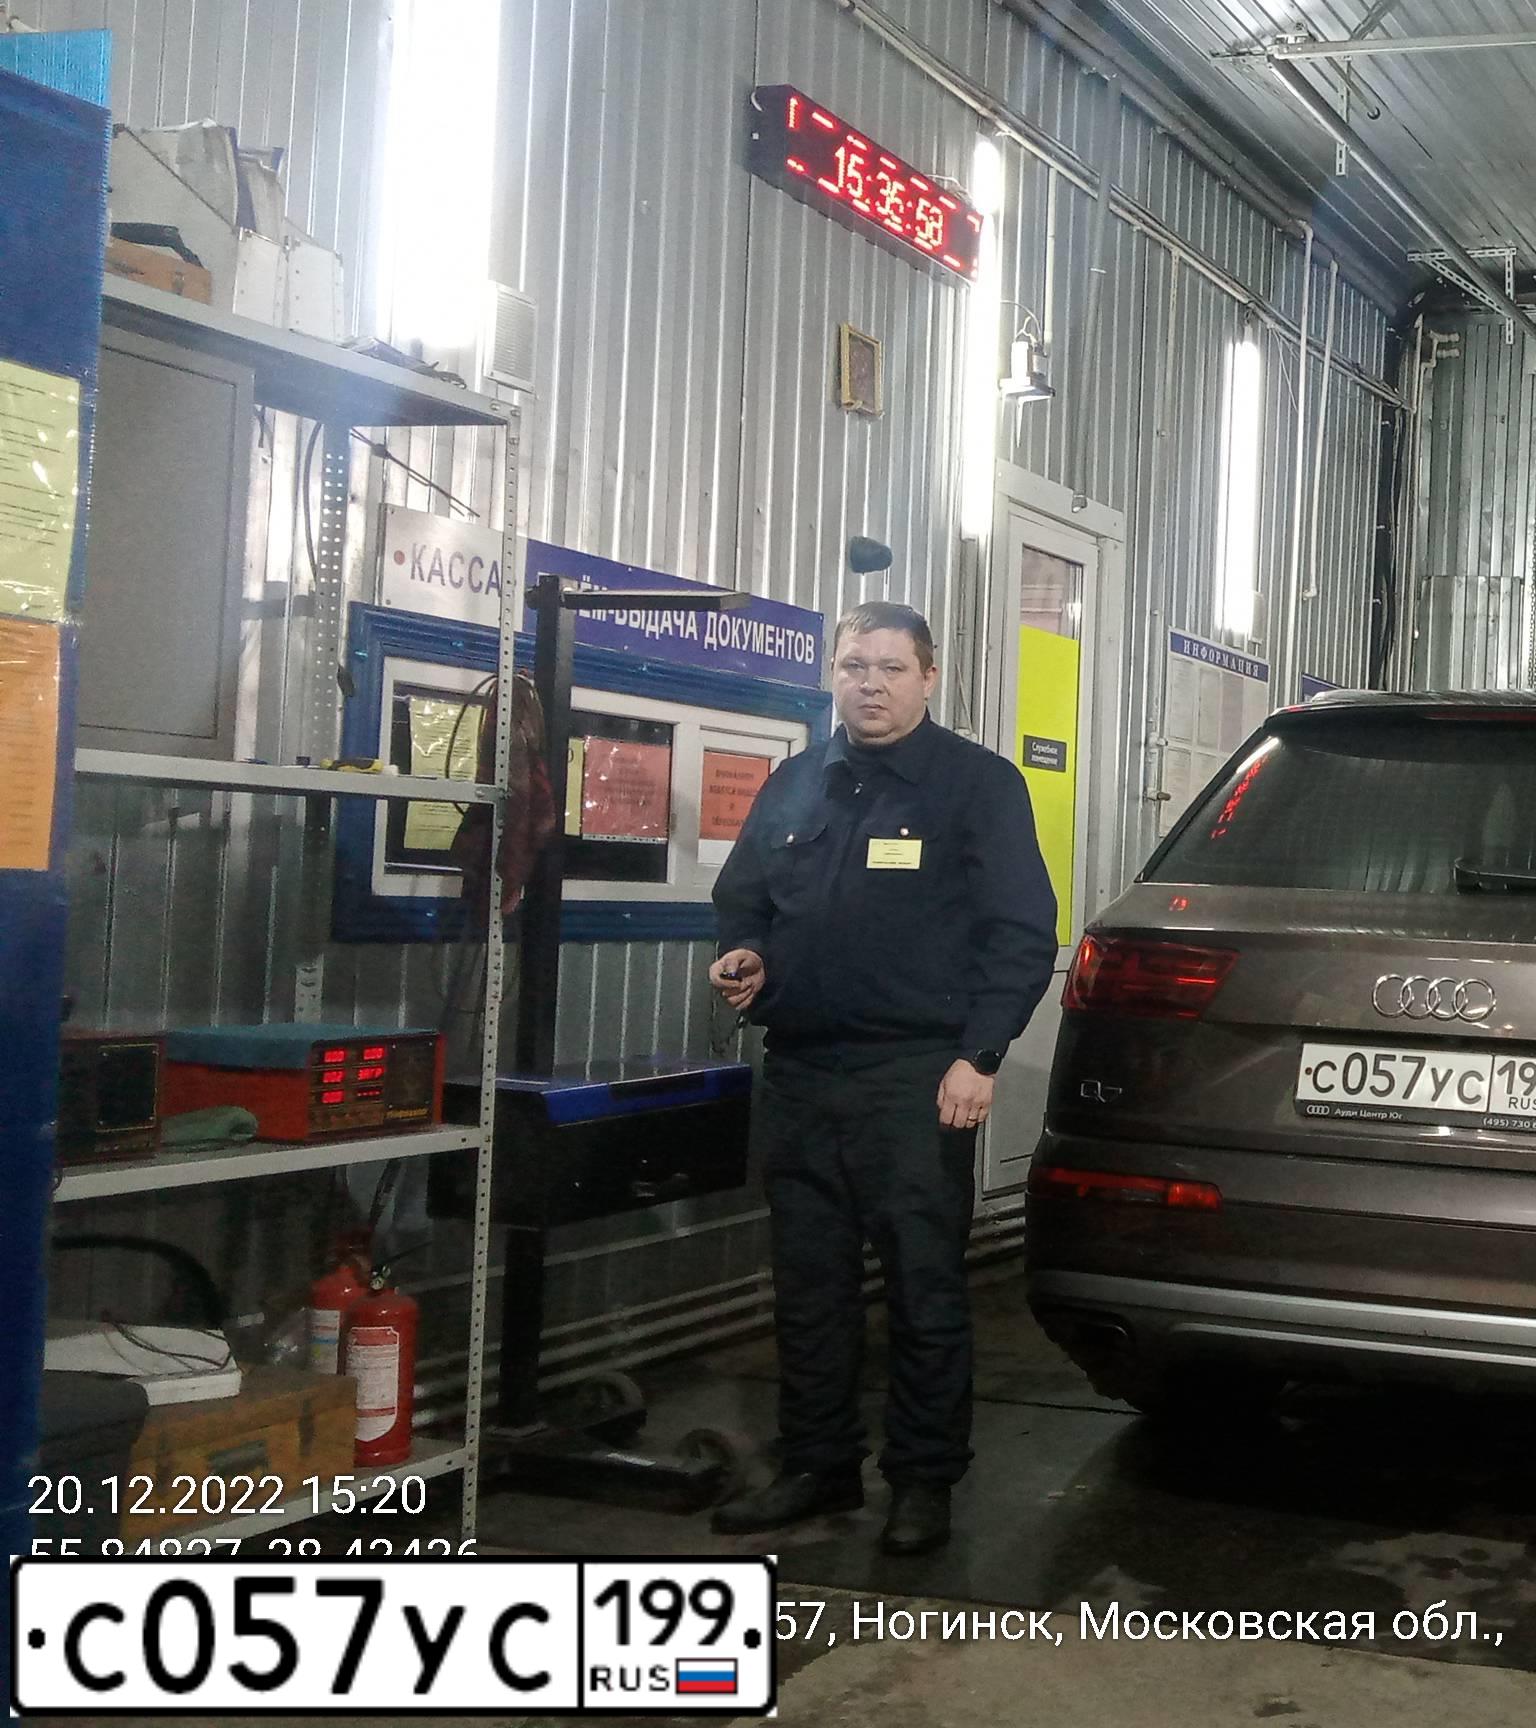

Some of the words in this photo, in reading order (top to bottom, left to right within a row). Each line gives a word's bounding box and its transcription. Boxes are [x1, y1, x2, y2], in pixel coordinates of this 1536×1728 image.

[411, 543, 502, 598] КАССА
[704, 610, 815, 665] ДОКУМЕНТОВ
[1183, 639, 1259, 677] ИНФОРМАЦИЯ
[1334, 1107, 1358, 1117] Ауди
[1359, 1109, 1388, 1120] Центр
[1482, 1116, 1509, 1127] (495)
[1512, 1119, 1531, 1129] 730
